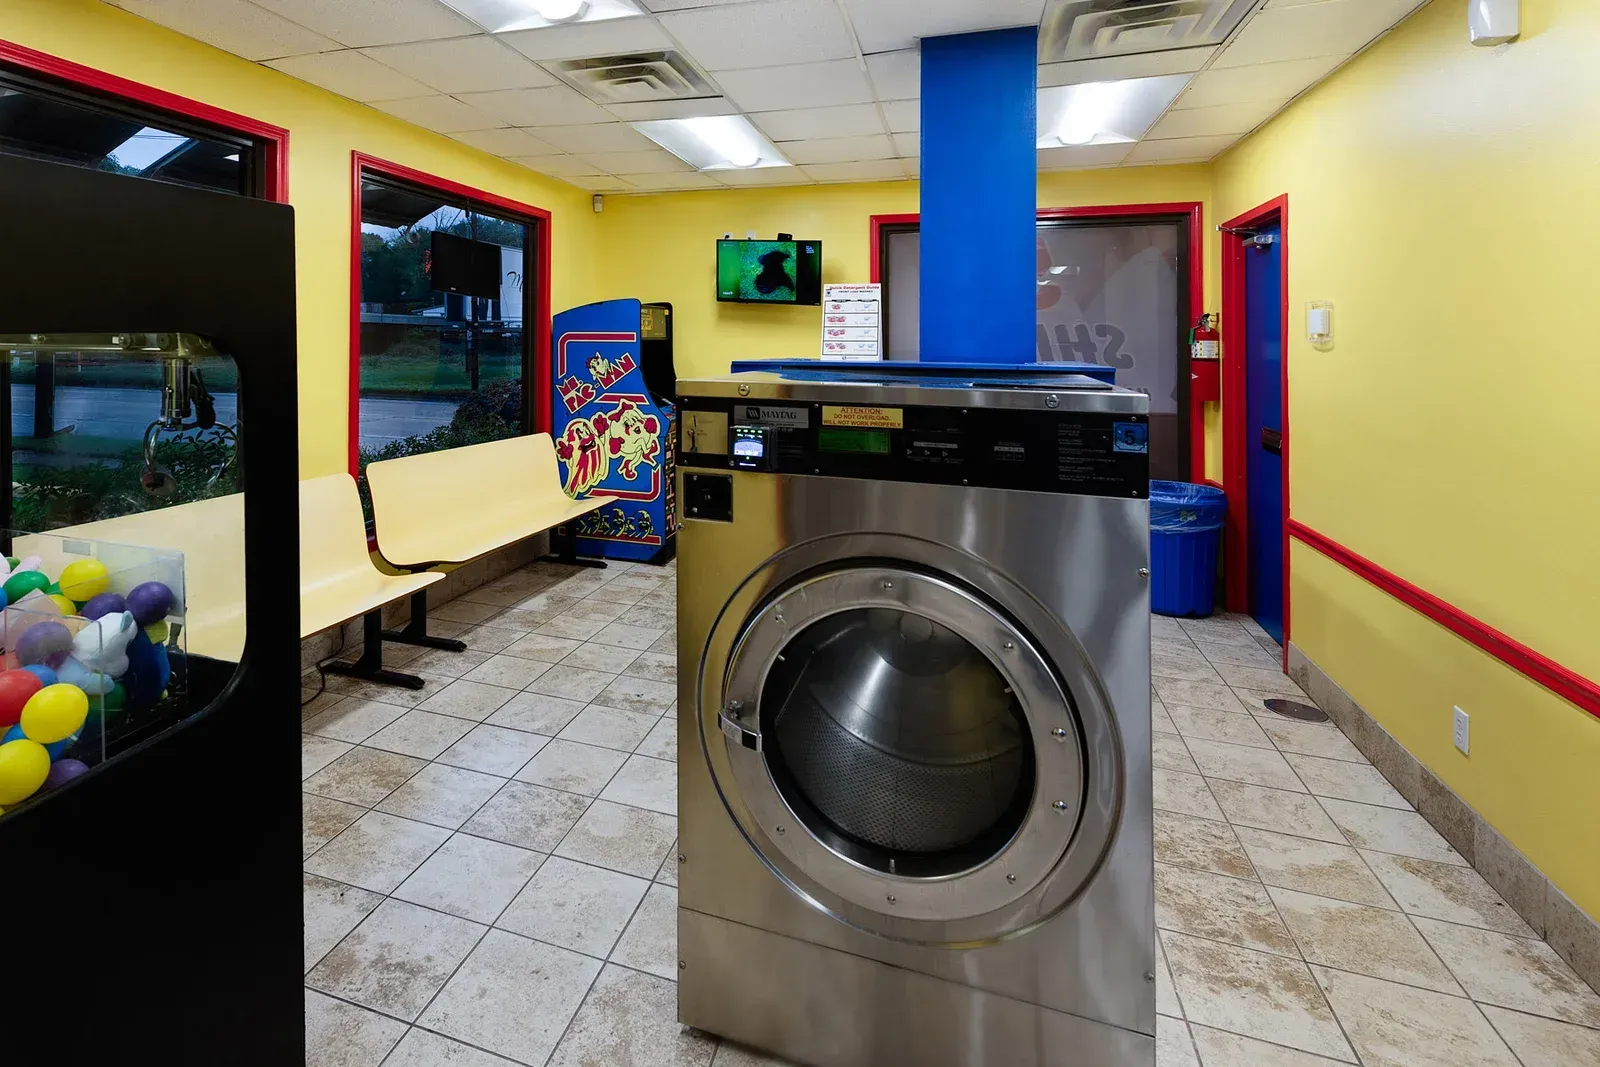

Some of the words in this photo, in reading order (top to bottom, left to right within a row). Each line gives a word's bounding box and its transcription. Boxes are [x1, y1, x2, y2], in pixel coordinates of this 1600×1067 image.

[761, 410, 797, 419] MAYTAG
[840, 407, 883, 415] ATTENTION:
[1124, 429, 1136, 446] 5
